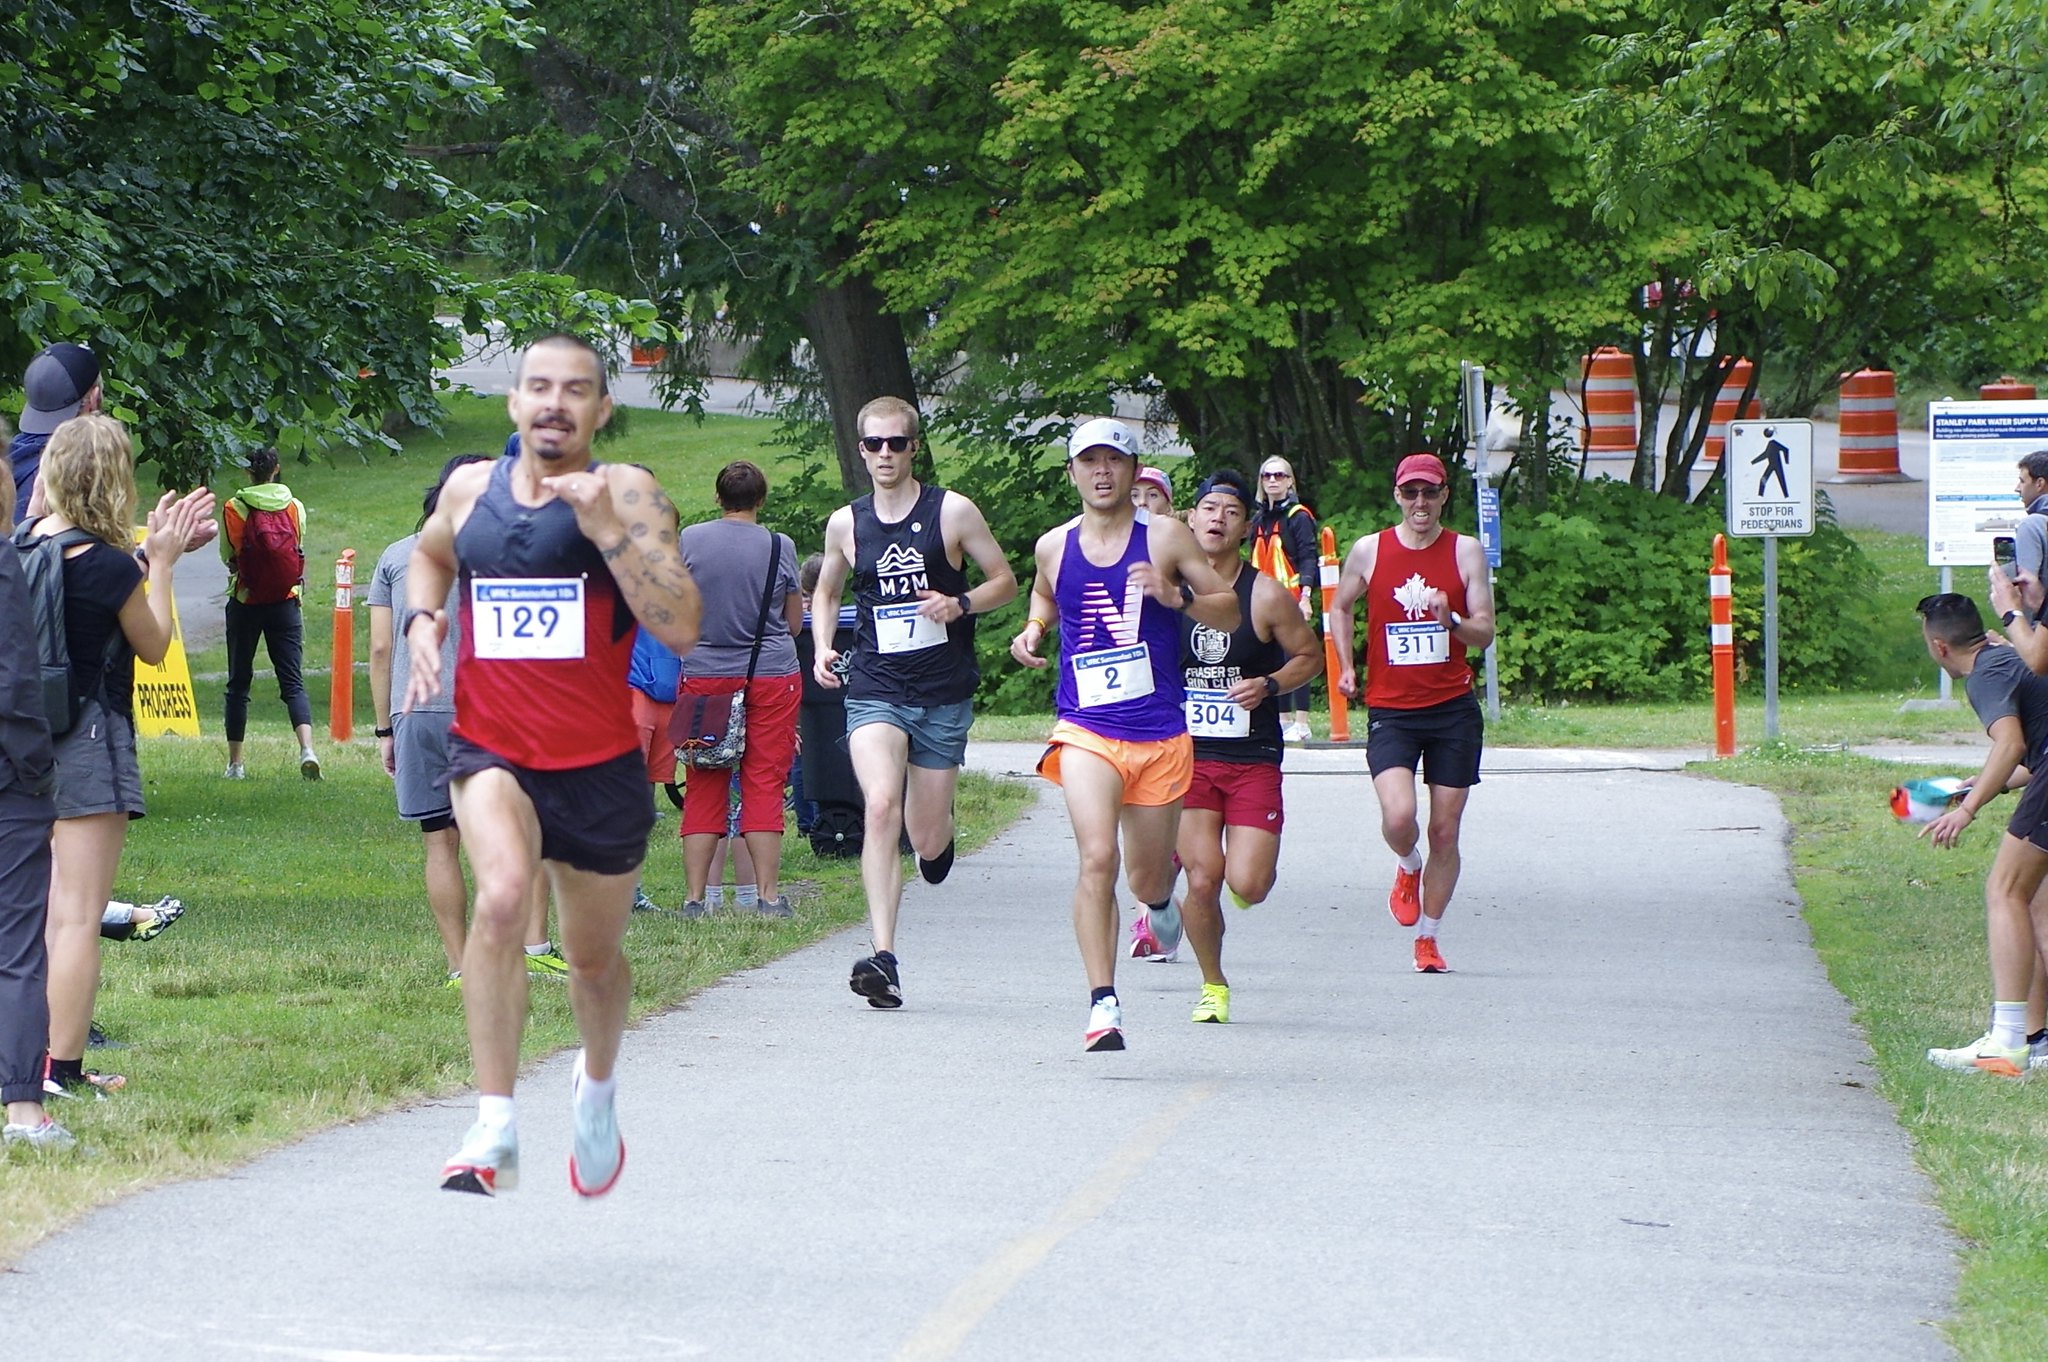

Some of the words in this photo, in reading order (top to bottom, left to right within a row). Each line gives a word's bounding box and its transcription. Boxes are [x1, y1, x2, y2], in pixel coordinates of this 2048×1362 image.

[1936, 418, 1967, 426] STANLEY
[1968, 418, 1987, 426] PARK
[1988, 418, 2012, 426] WATER
[2013, 417, 2039, 425] SUPPLY
[1749, 506, 1773, 517] STOP
[1775, 506, 1794, 516] FOR
[1741, 519, 1803, 530] PEDESTRIANS
[879, 573, 929, 597] M2M
[493, 606, 559, 638] 129
[903, 619, 915, 638] 7
[1398, 635, 1434, 654] 311
[1105, 667, 1121, 689] 2
[1185, 667, 1225, 678] FRASER
[1227, 667, 1241, 676] ST
[1187, 678, 1208, 689] RUN
[137, 683, 191, 719] PROGRESS
[1192, 704, 1235, 726] 304
